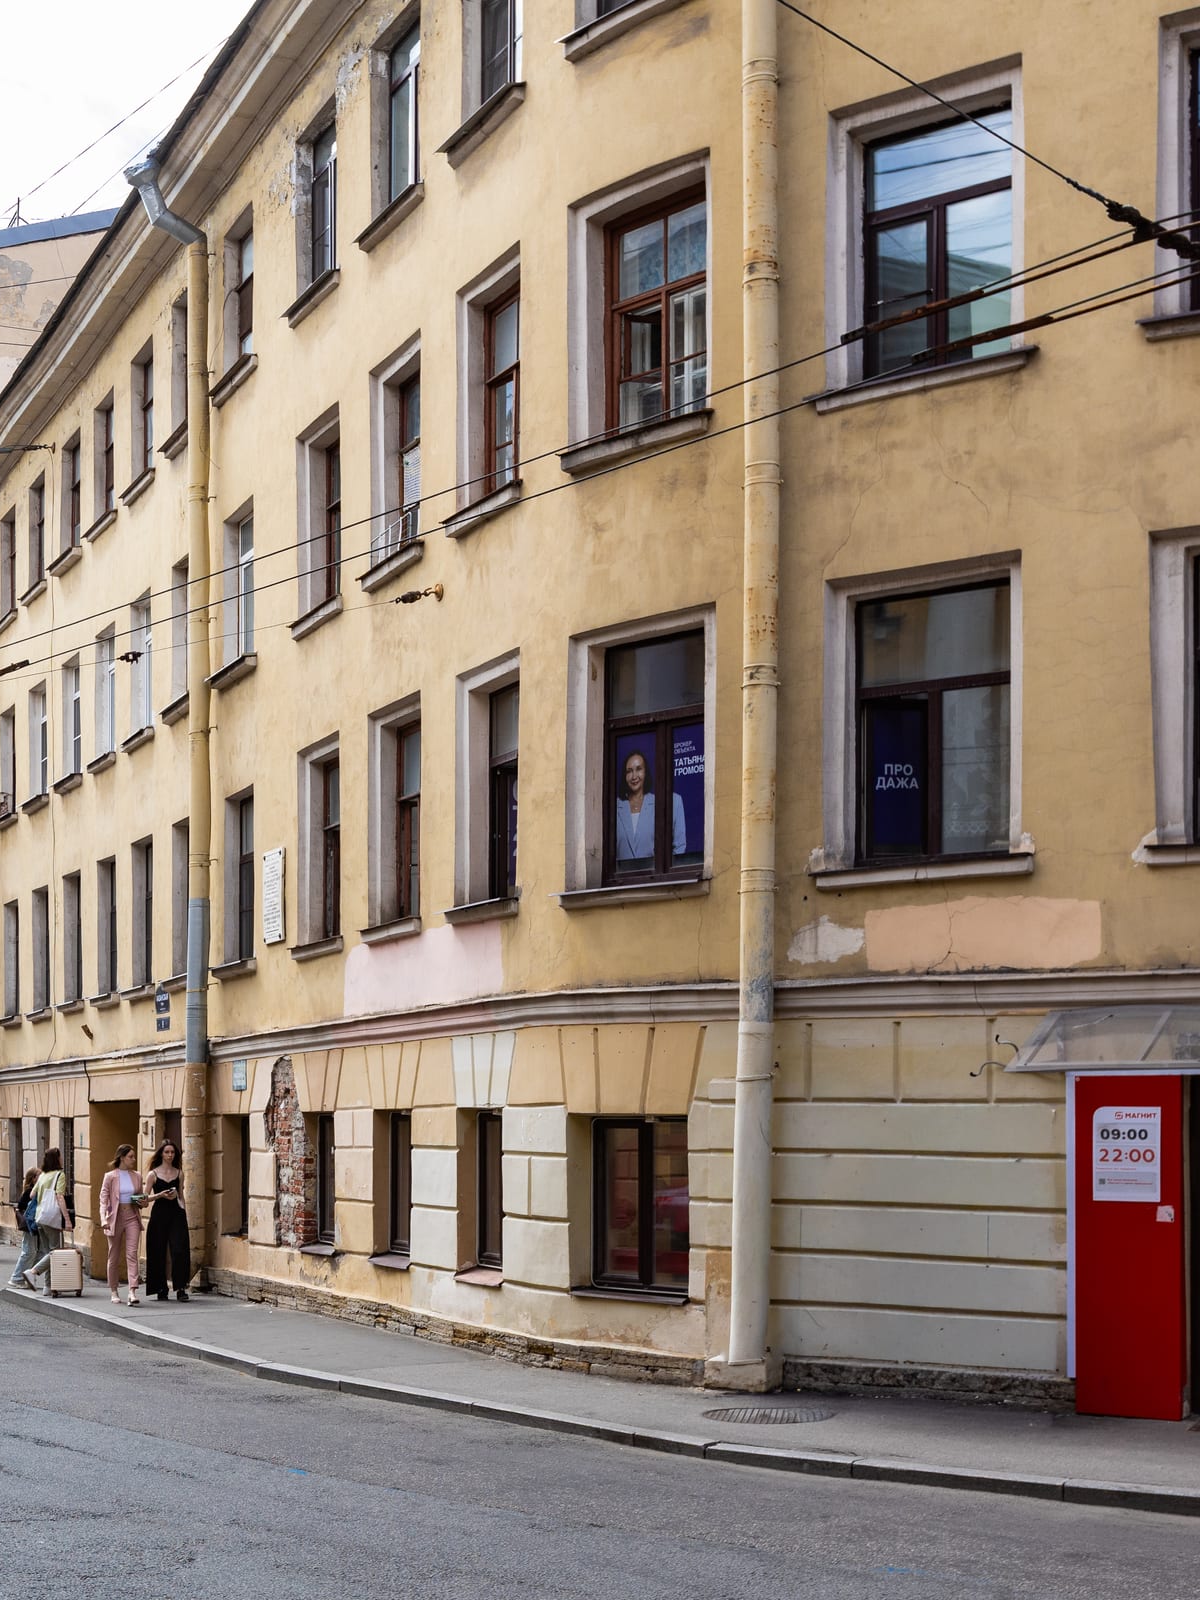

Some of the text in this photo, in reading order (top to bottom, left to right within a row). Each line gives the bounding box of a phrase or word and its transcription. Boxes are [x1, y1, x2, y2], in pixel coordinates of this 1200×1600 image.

[884, 763, 913, 776] ПРО
[875, 776, 920, 791] ДАЖА
[1100, 1128, 1148, 1140] 09:00
[1099, 1148, 1155, 1163] 22:00
